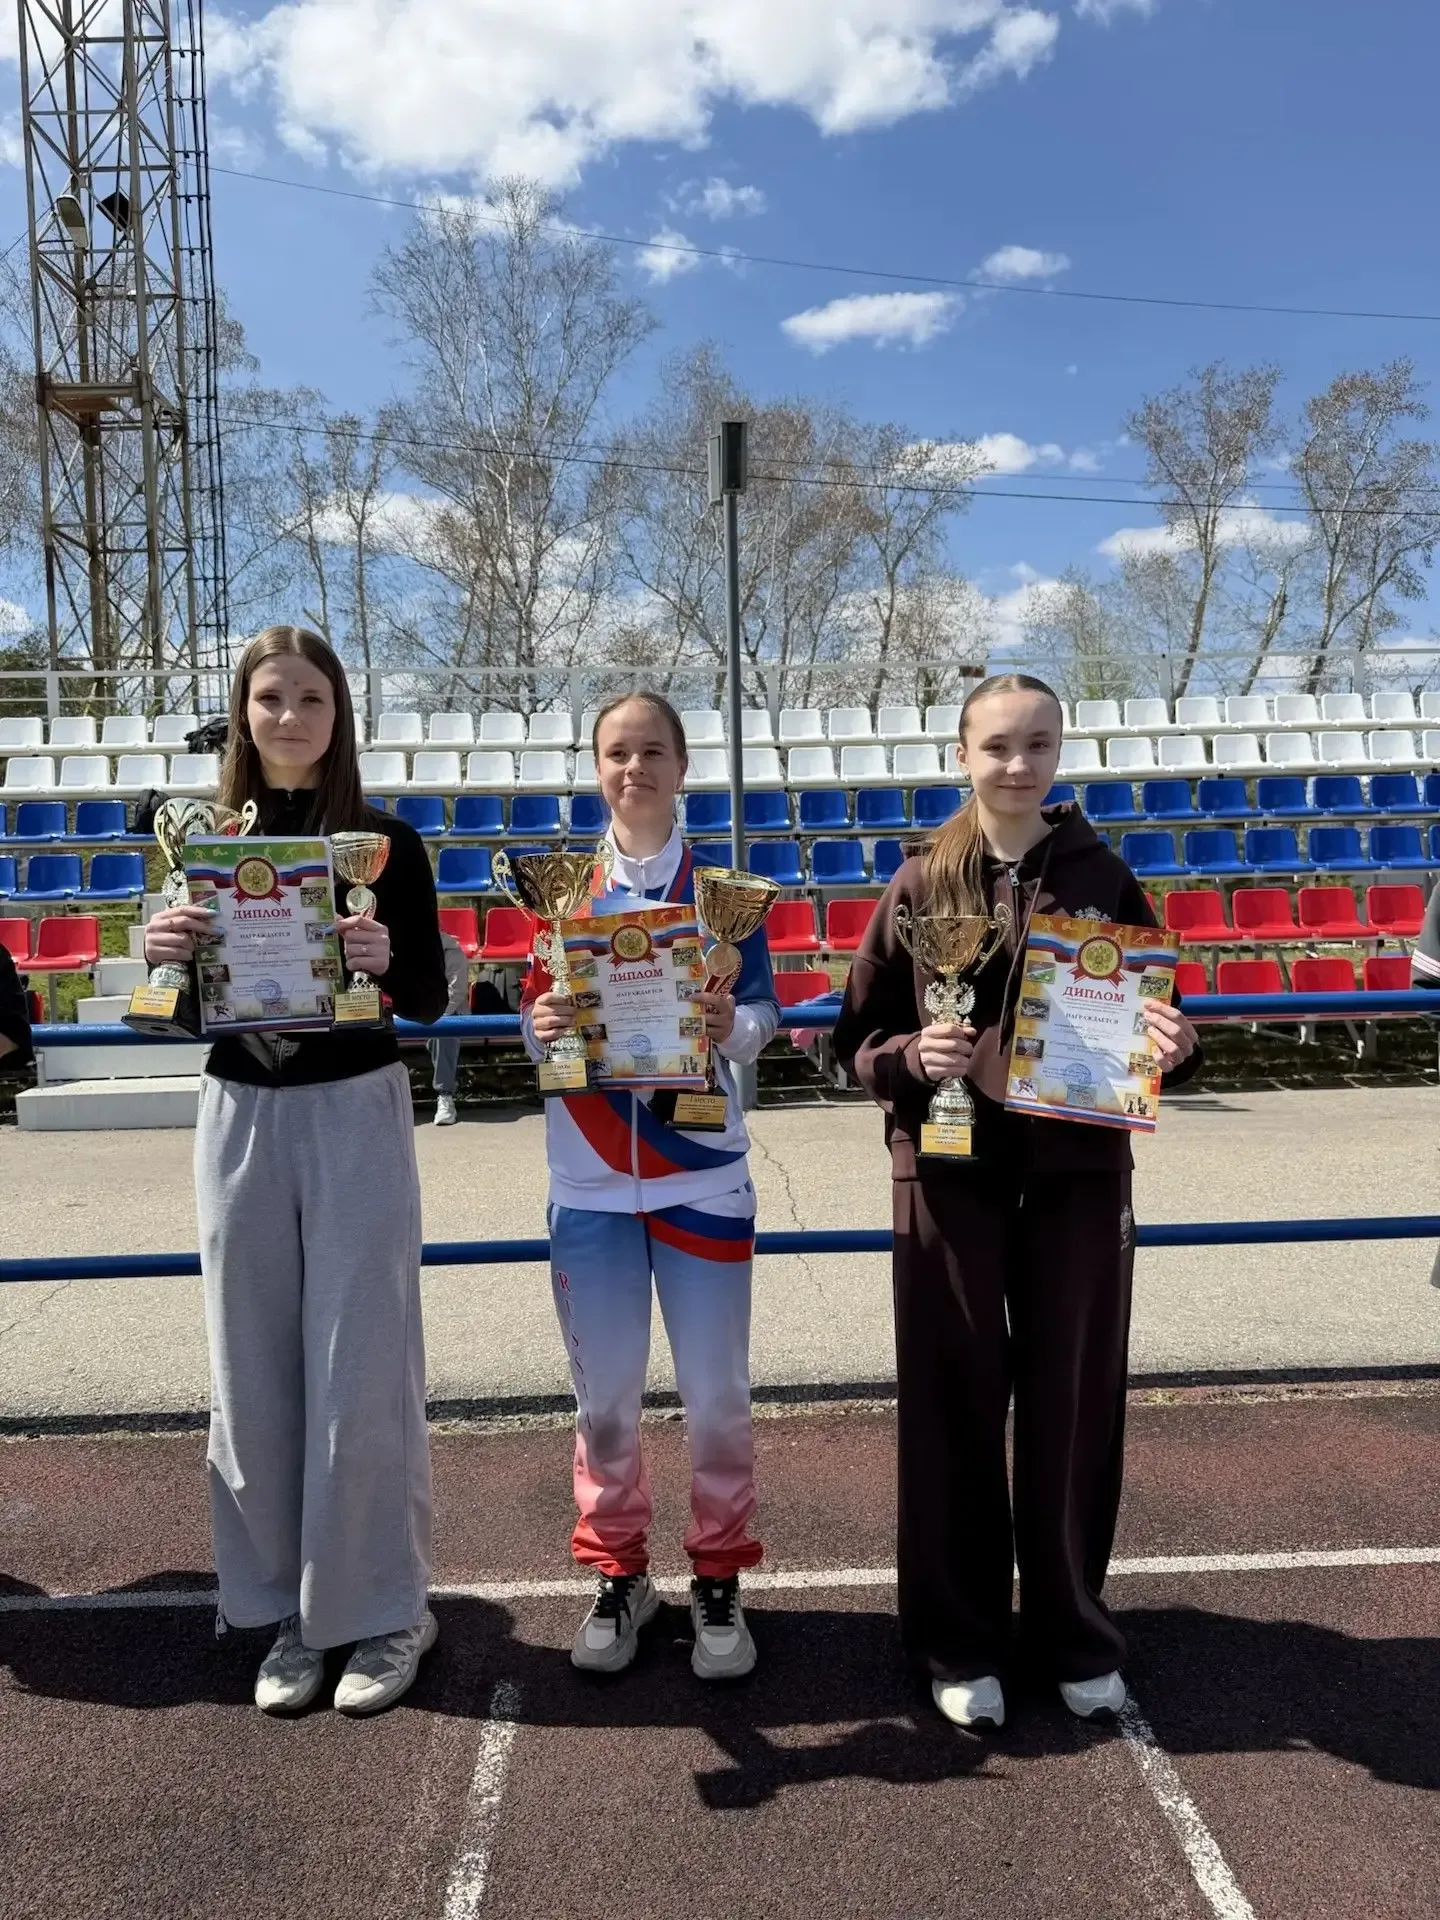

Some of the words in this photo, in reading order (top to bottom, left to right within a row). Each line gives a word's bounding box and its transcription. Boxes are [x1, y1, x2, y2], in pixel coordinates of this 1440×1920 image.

[233, 908, 292, 920] ДИПЛОМ
[608, 969, 663, 983] ДИПЛОМ
[616, 989, 663, 998] НАГРАЖДАЕТСЯ
[1062, 986, 1125, 1003] ДИПЛОМ
[1065, 1012, 1119, 1025] НАГРАЖДАЕТСЯ
